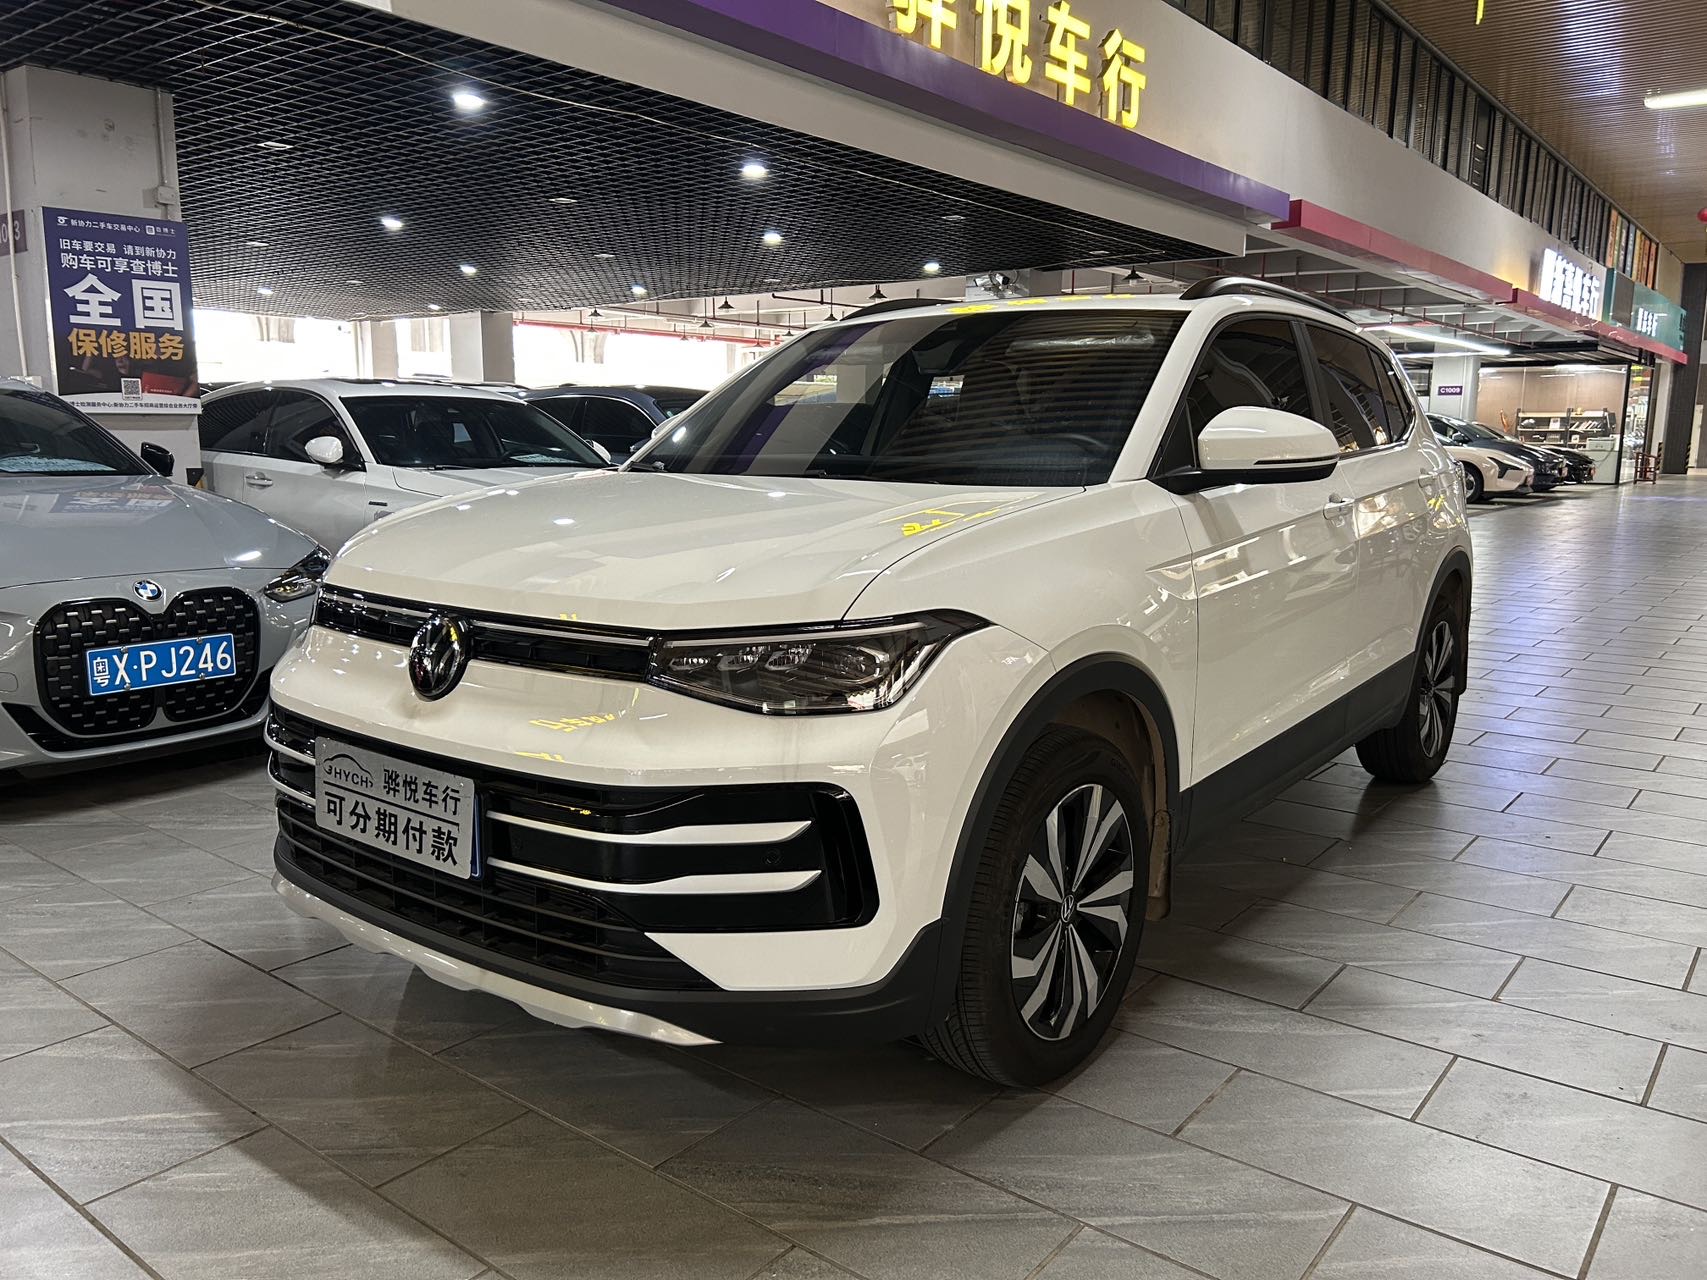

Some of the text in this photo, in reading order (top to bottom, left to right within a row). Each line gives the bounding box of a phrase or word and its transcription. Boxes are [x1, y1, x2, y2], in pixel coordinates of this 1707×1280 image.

[70, 218, 141, 233] 新协力二手车交易中心
[59, 238, 177, 260] 旧车要交易 请到新协力
[60, 252, 179, 277] 购车可享查博士
[63, 273, 184, 331] 全国
[67, 328, 185, 361] 保修服务
[382, 768, 461, 816] 骅悦车行
[324, 790, 460, 867] 可分期付款
